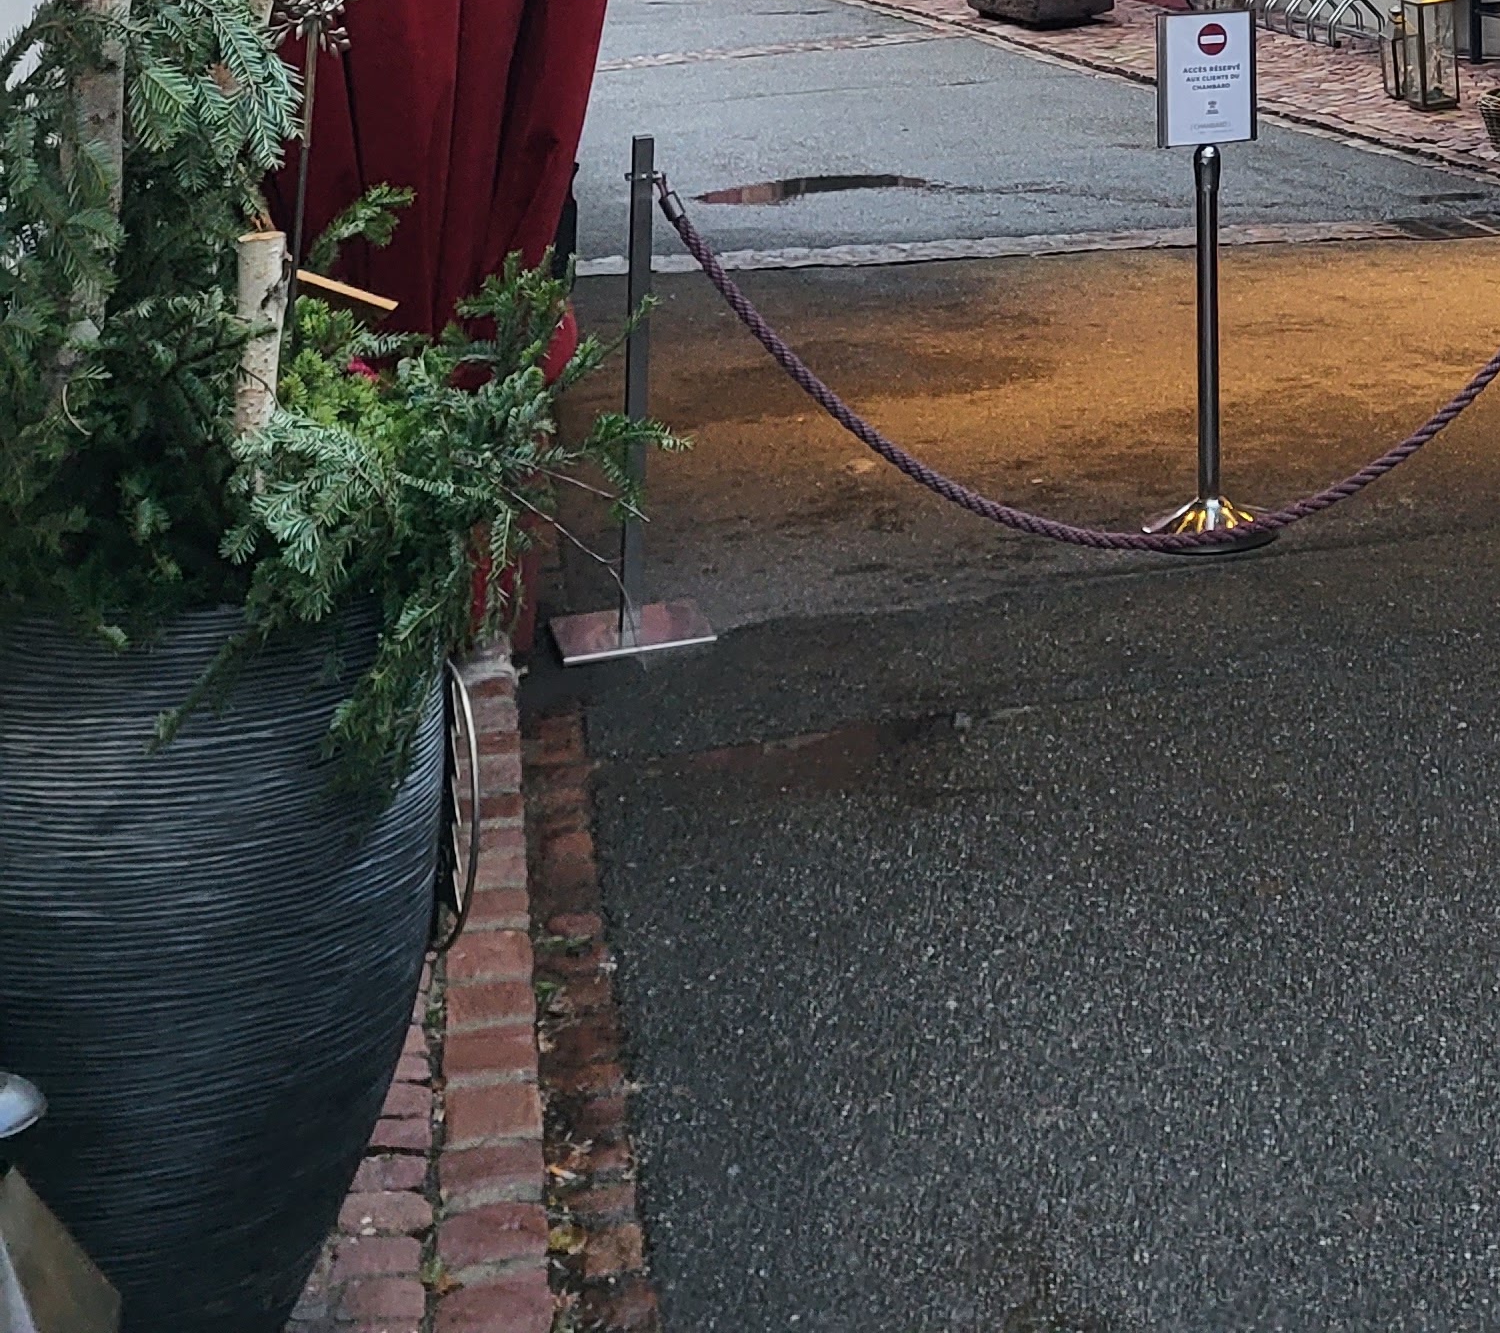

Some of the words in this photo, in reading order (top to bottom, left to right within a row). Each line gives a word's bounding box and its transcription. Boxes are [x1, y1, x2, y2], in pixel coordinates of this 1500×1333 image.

[1182, 66, 1208, 74] ACCÈS
[1209, 63, 1241, 72] RÉSERVÉ
[1202, 74, 1229, 82] CLIENTS
[1191, 83, 1231, 91] CHAMBARD
